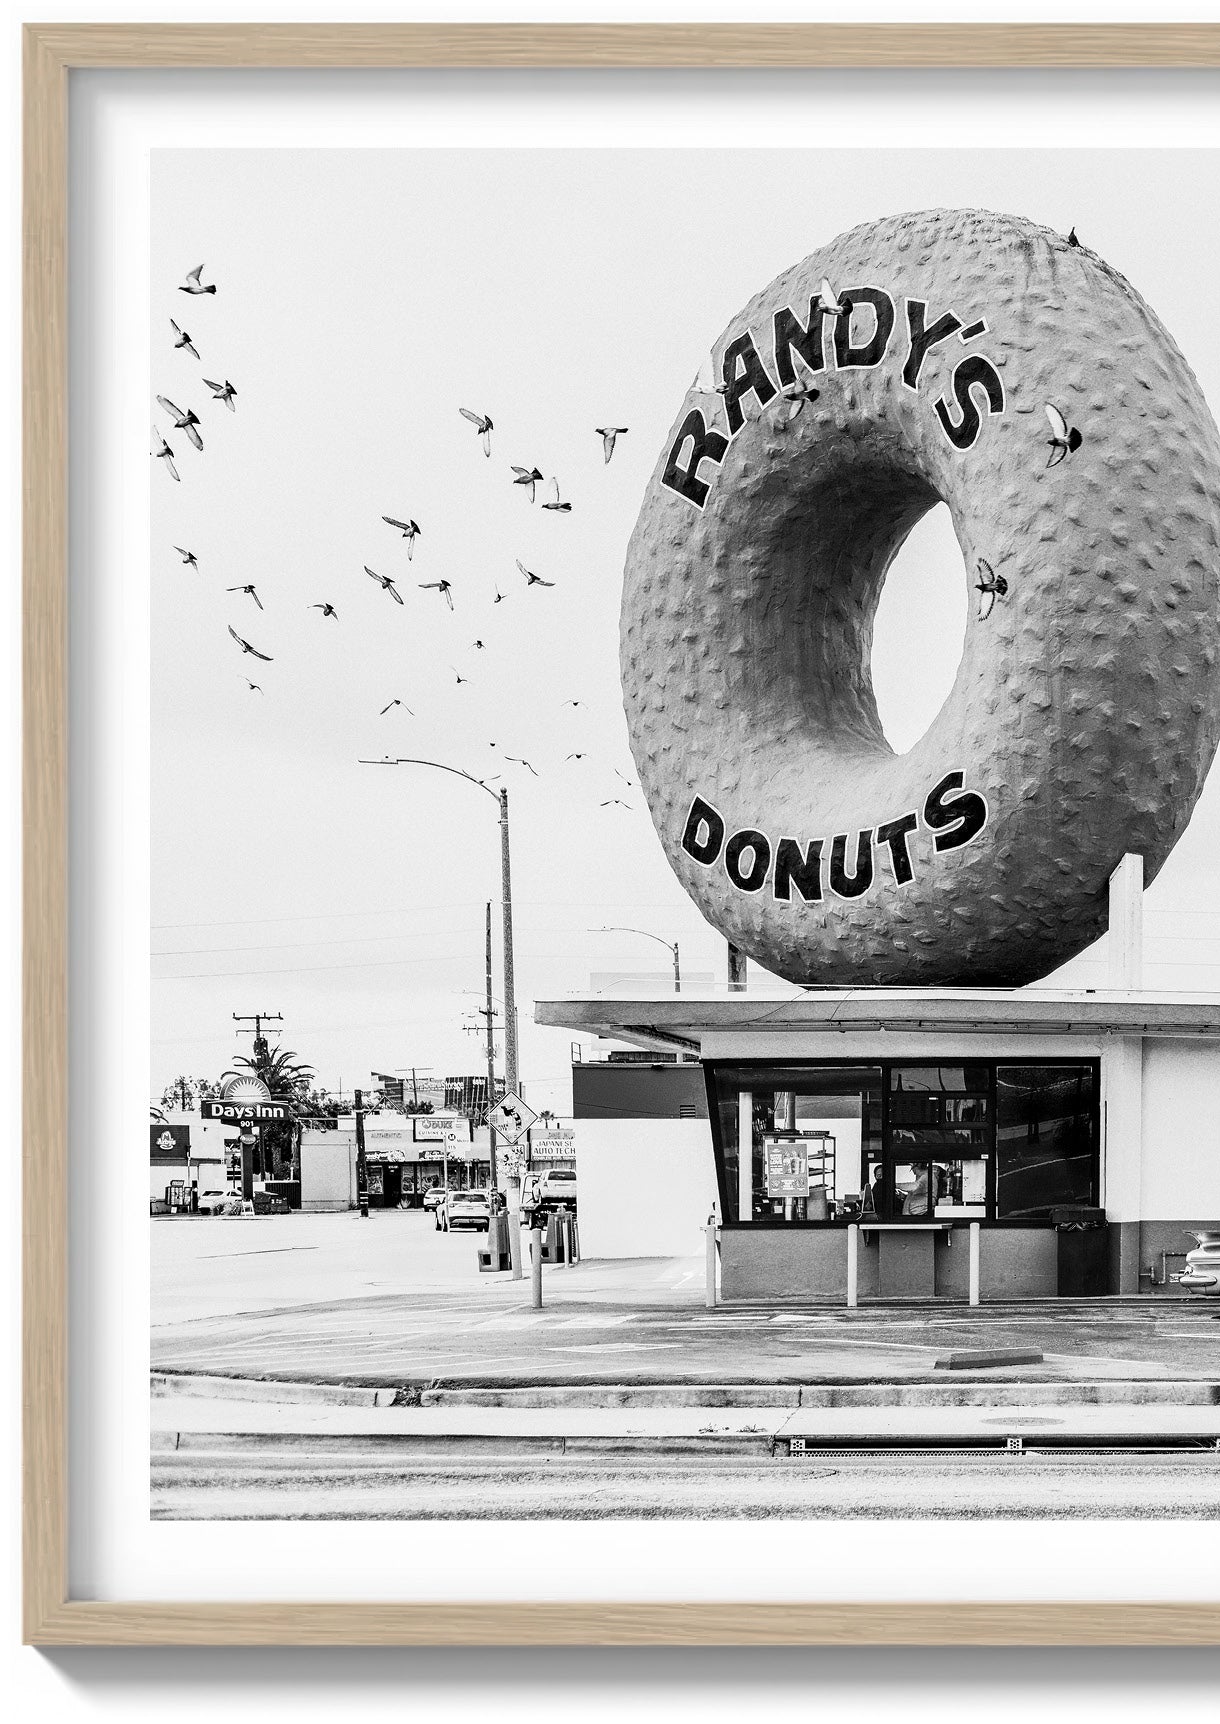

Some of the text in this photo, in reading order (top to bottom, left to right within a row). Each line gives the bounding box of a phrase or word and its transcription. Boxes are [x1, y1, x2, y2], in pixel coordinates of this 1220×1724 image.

[661, 286, 1006, 512] RANDY'S
[681, 768, 988, 902] DONUTS
[211, 1103, 285, 1119] Days Inn
[534, 1147, 576, 1155] AUTO TECH
